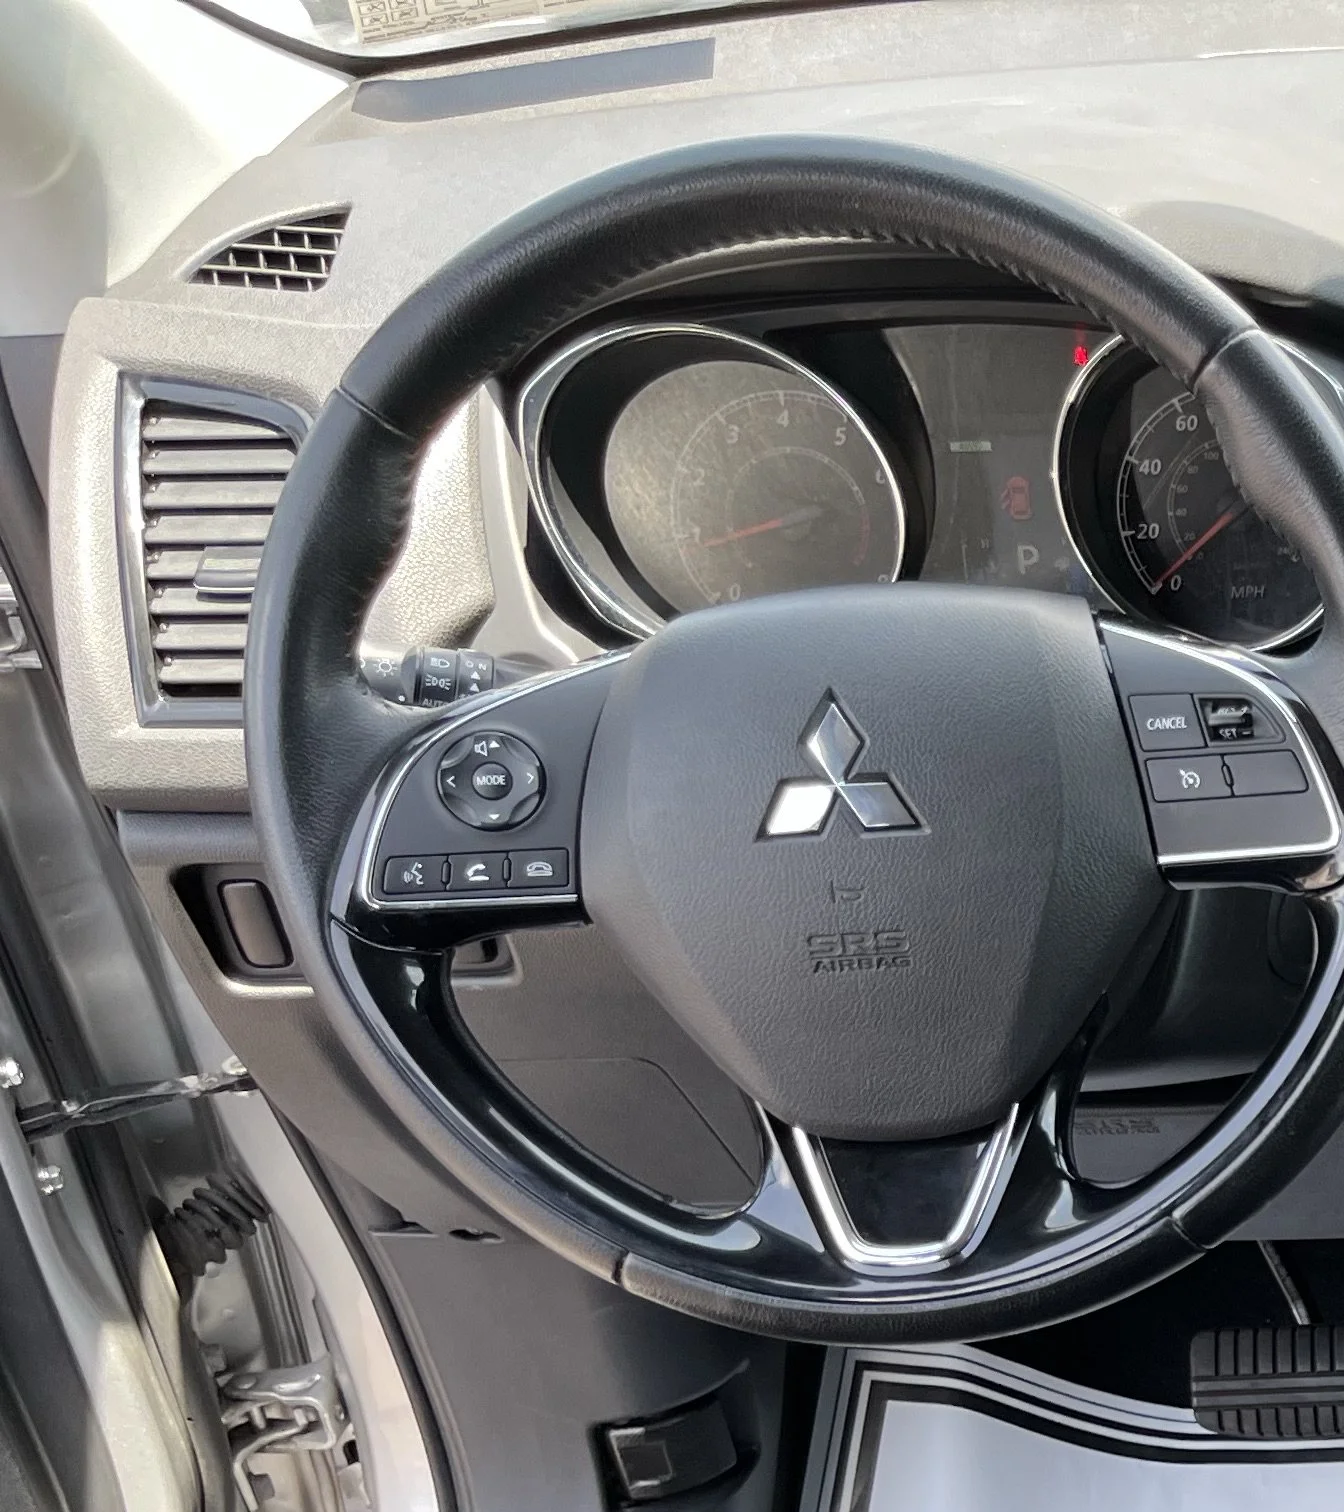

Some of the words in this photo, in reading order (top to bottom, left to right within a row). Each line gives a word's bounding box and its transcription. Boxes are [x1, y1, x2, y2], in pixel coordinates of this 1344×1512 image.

[776, 410, 790, 428] 4
[1175, 415, 1198, 431] 60
[726, 425, 740, 443] 3
[834, 427, 847, 446] 5
[1139, 459, 1162, 475] 40
[1137, 523, 1160, 539] 20
[1016, 544, 1040, 574] P
[1170, 575, 1182, 591] 0
[729, 584, 741, 600] 0
[1230, 586, 1265, 599] MPH
[1146, 716, 1188, 731] CANCEL
[476, 774, 506, 786] MODE
[807, 930, 911, 958] SRS
